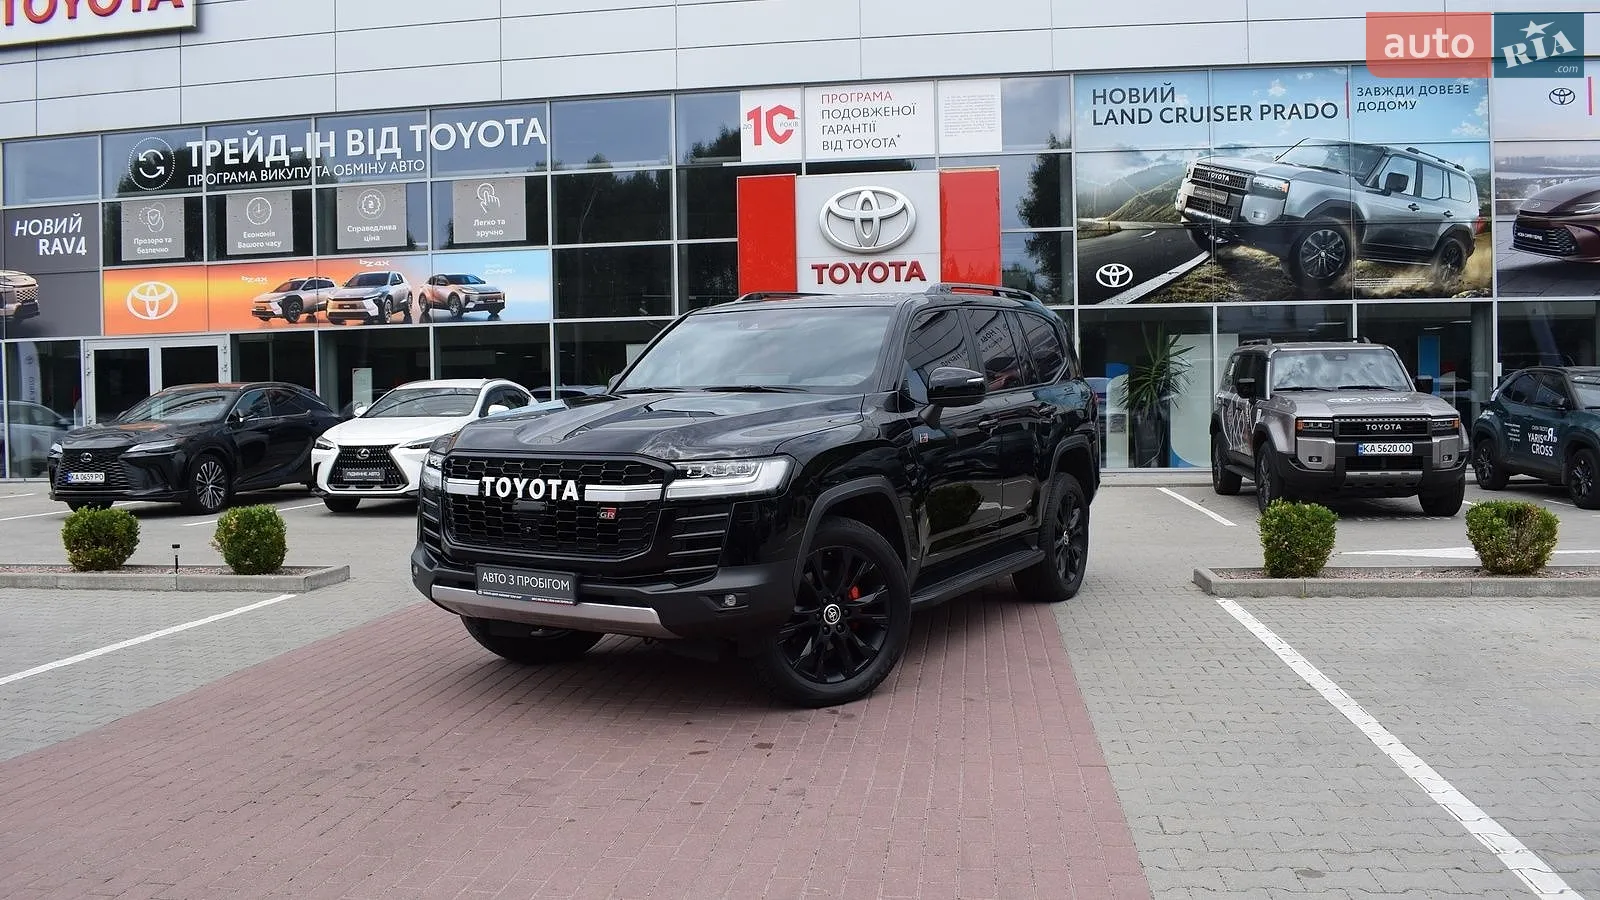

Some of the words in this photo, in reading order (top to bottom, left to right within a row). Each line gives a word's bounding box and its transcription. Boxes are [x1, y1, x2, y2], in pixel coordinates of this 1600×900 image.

[1092, 82, 1175, 104] НОВИЙ
[1356, 85, 1415, 97] ЗАВЖДИ
[1418, 84, 1470, 96] ДОВЕЗЕ
[821, 90, 892, 105] ПРОГРАМА
[821, 103, 916, 120] ПОДОВЖЕНОЇ
[1356, 100, 1417, 113] ДОДОМУ
[1092, 107, 1153, 126] LAND
[1159, 104, 1253, 124] CRUISER
[1260, 102, 1338, 121] PRADO
[821, 121, 877, 135] ГАРАНТІЇ
[186, 129, 336, 167] ТРЕЙД-ІН
[347, 126, 401, 160] ВІД
[409, 117, 547, 152] TOYOTA
[822, 139, 843, 152] ВІД
[188, 169, 257, 186] ПРОГРАМА
[260, 165, 312, 181] ВИКУПУ
[316, 165, 330, 177] ТА
[333, 161, 387, 176] ОБМІНУ
[389, 159, 425, 173] АВТО
[14, 212, 83, 237] НОВИЙ
[347, 224, 397, 234] Справедлива
[473, 218, 497, 227] Легко
[497, 218, 506, 226] та
[243, 230, 276, 240] Економія
[363, 234, 381, 243] ціна
[475, 228, 504, 238] зручно
[38, 236, 87, 256] RAV4
[265, 240, 282, 249] часу
[811, 260, 927, 285] TOYOTA
[1365, 423, 1402, 431] TOYOTA
[1527, 432, 1544, 444] YARIS
[1377, 444, 1398, 453] 5620
[1531, 443, 1554, 457] CROSS
[482, 476, 579, 501] TOYOTA
[600, 511, 615, 520] GR
[482, 572, 506, 584] АВТО
[508, 574, 515, 585] З
[517, 575, 570, 591] ПРОБІГОМ
